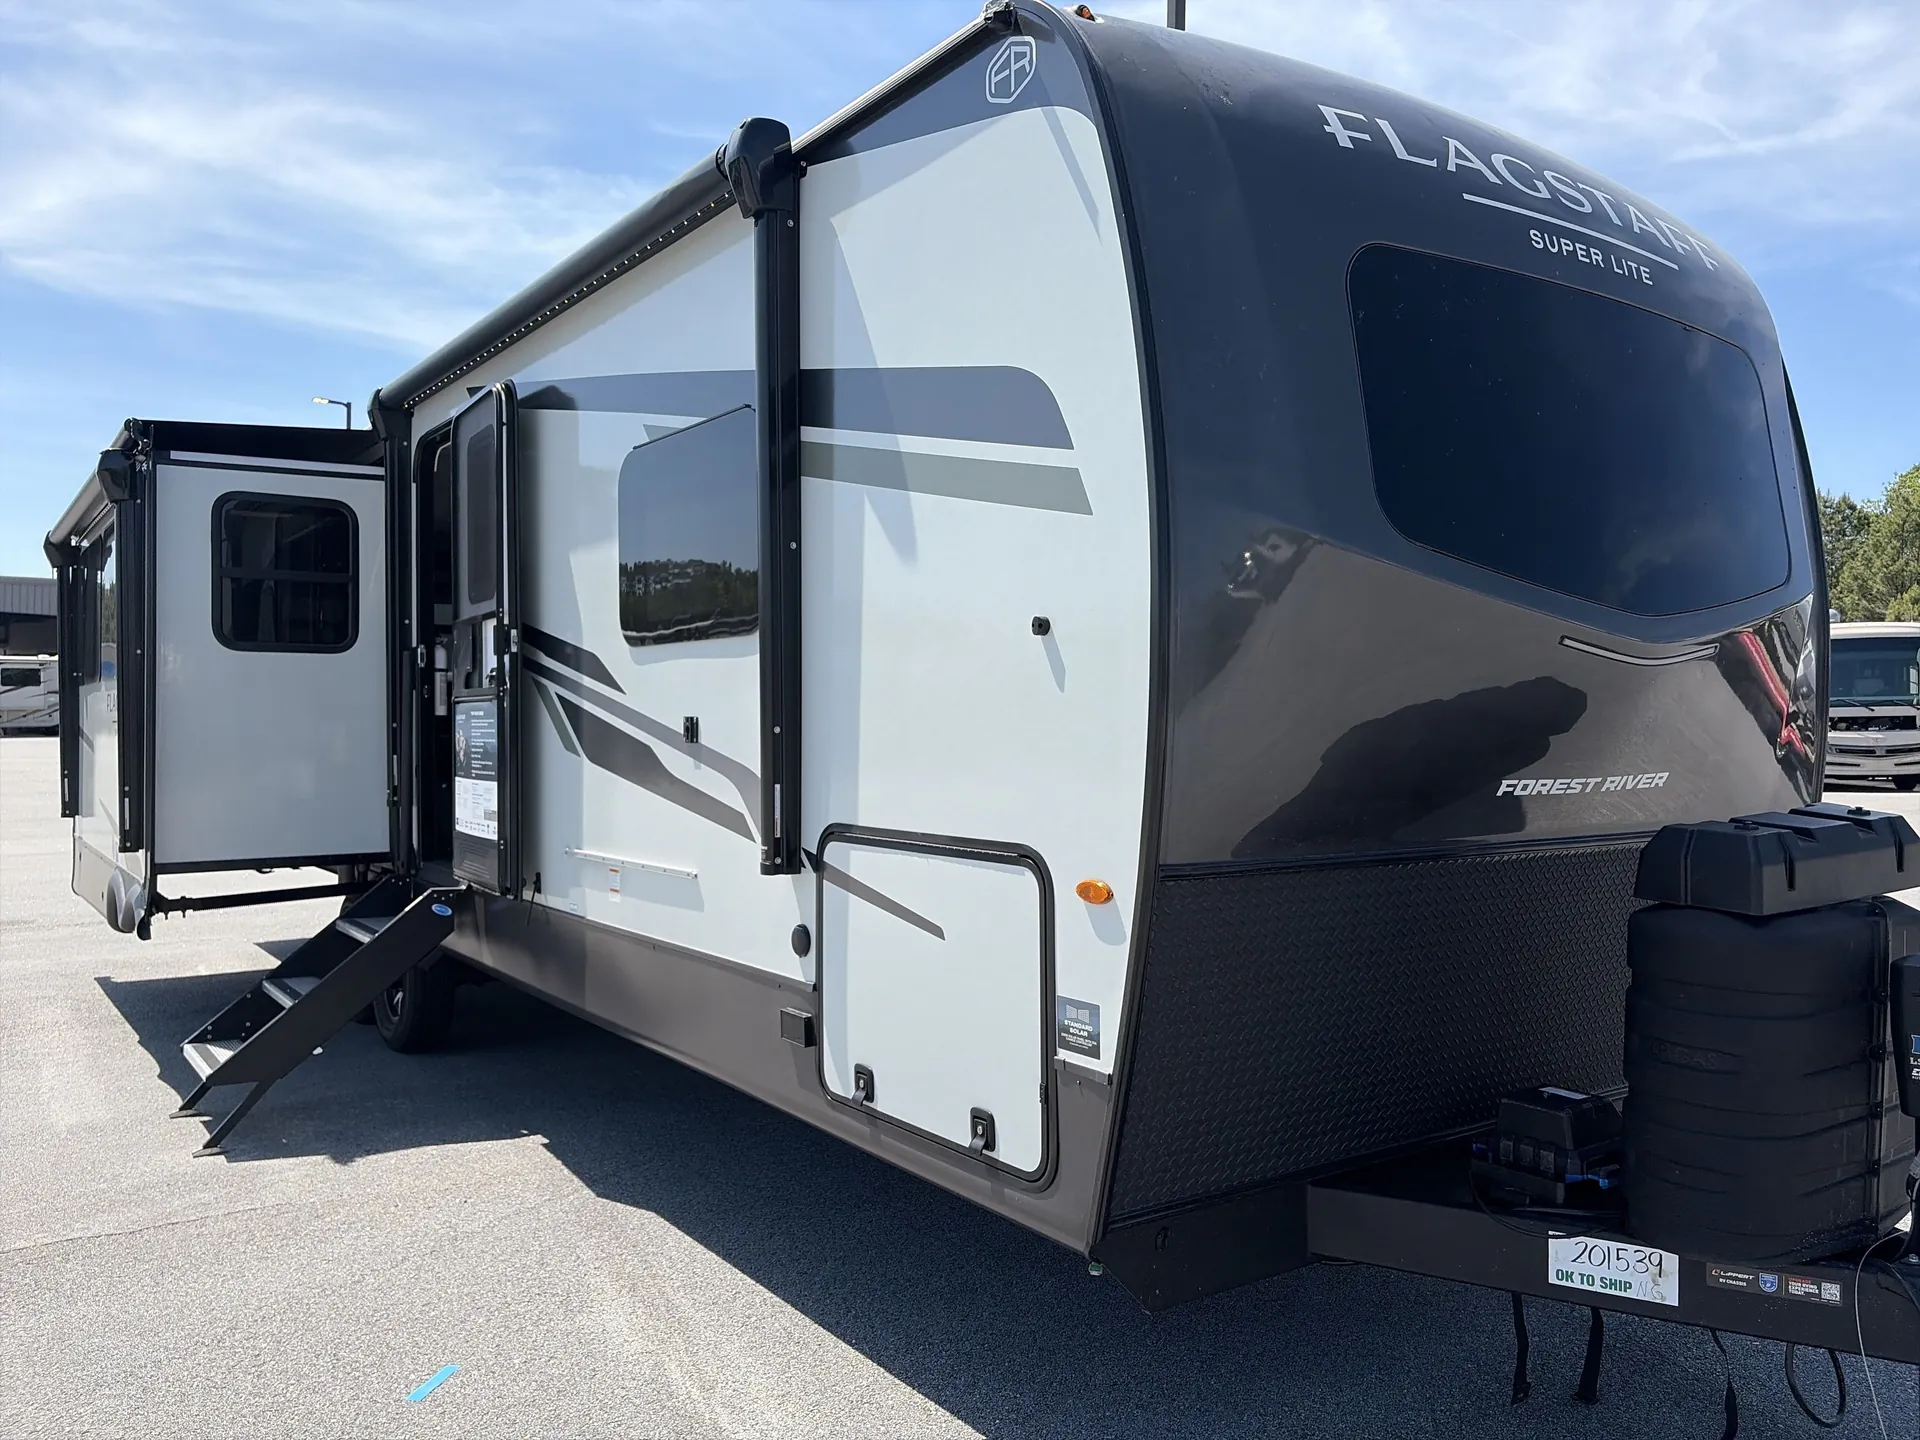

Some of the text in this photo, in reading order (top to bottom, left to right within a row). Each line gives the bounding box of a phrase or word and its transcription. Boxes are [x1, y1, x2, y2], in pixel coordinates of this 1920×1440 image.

[1316, 103, 1721, 271] FLAGSTAFF
[1529, 229, 1653, 286] SUPER LITE
[1496, 772, 1669, 796] FOREST RIVER
[1064, 1019, 1093, 1032] STANDARD
[1069, 1027, 1088, 1038] SOLAR
[1571, 1240, 1663, 1279] 201539
[1555, 1268, 1633, 1293] OK TO SHIP
[1726, 1279, 1747, 1287] CHASSIS
